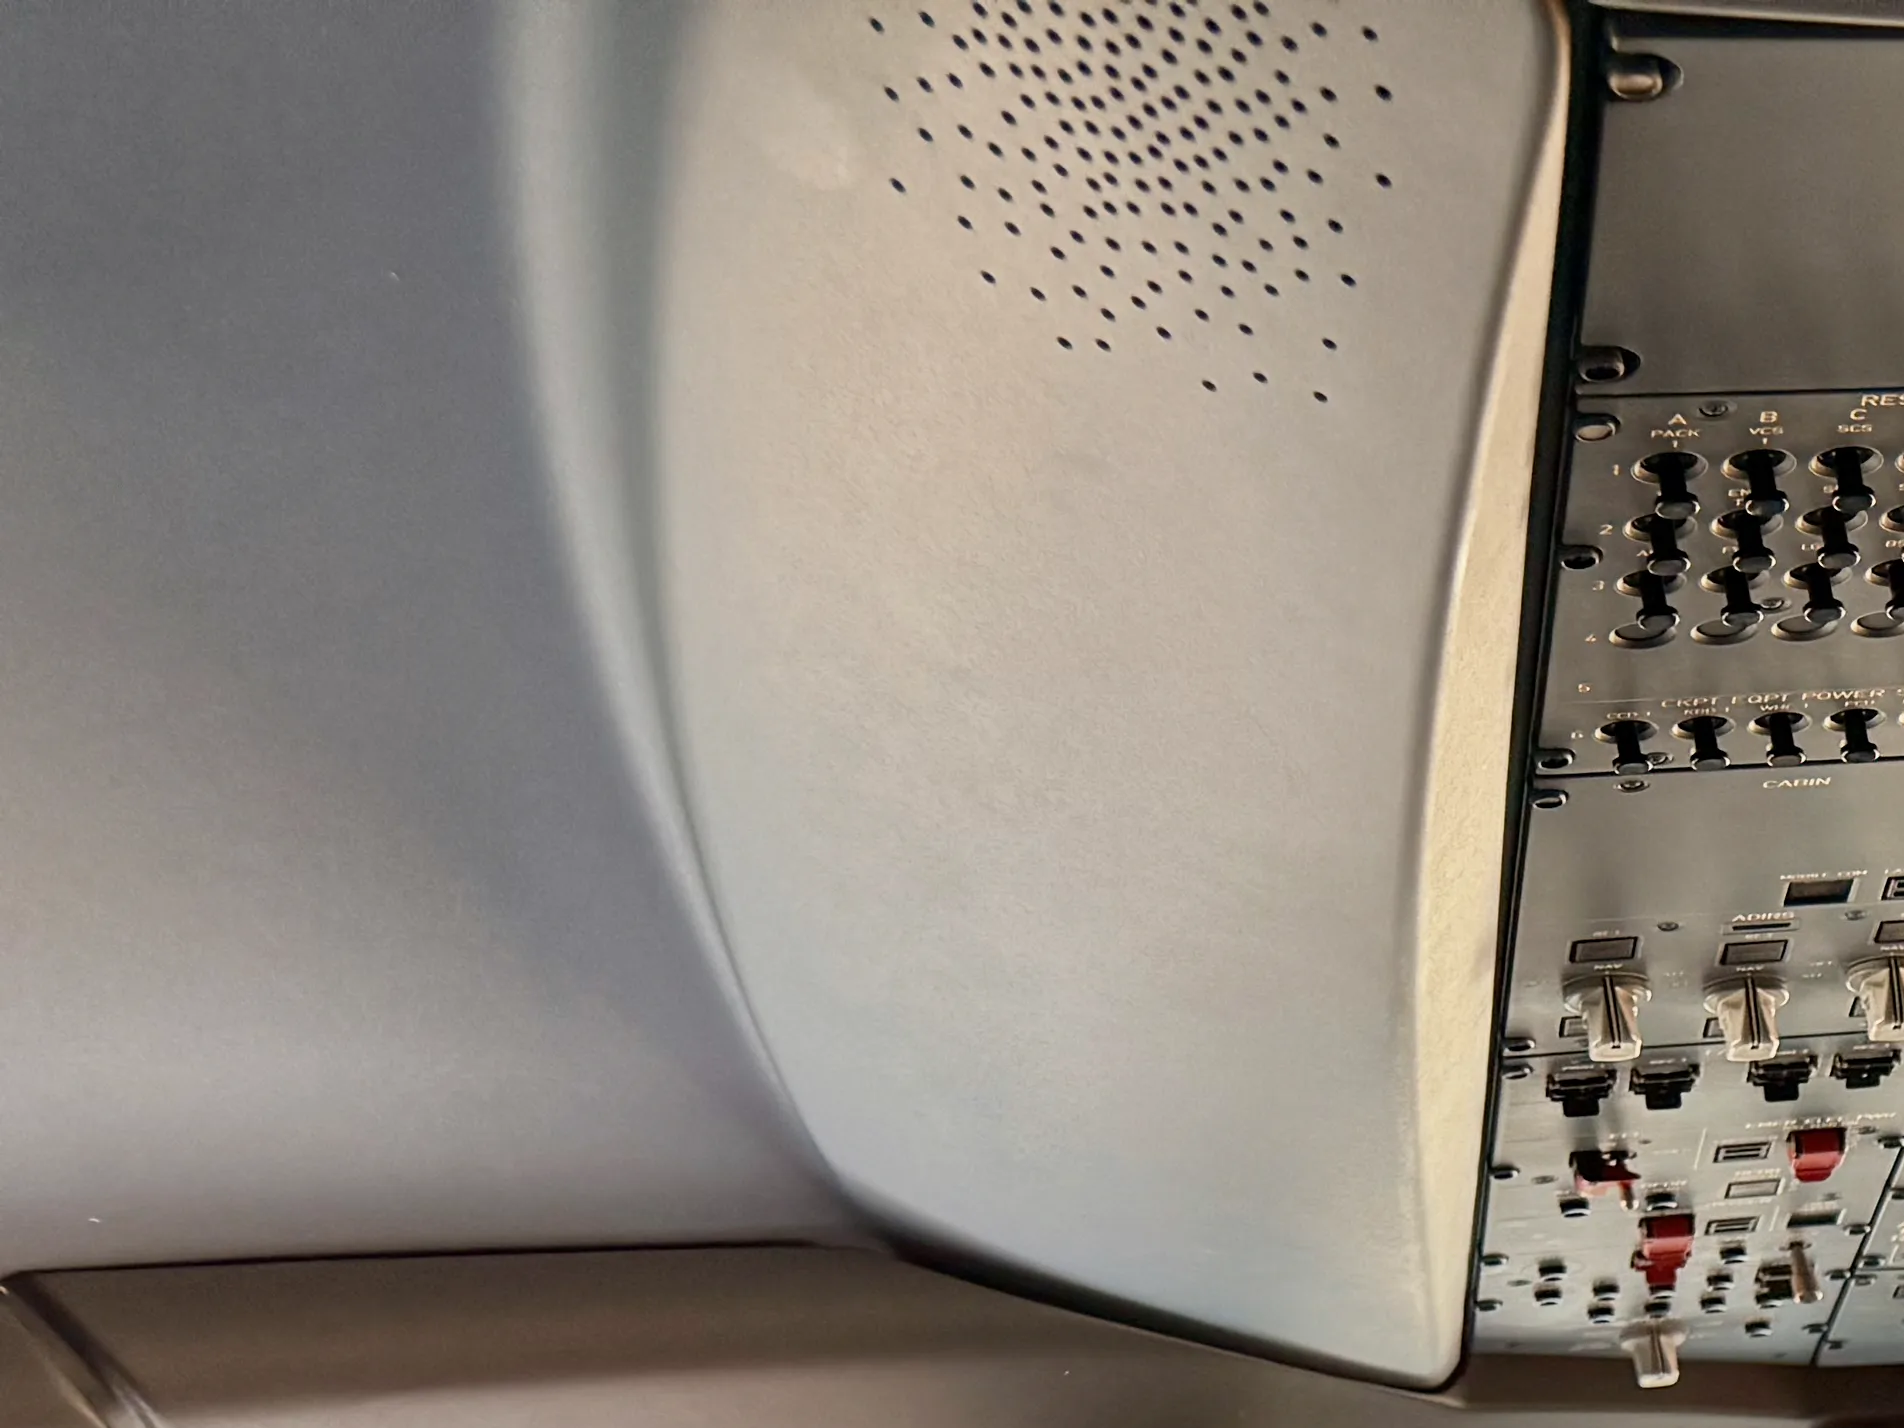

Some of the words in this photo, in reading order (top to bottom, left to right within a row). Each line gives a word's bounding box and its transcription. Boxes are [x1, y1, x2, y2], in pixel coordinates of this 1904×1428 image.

[1667, 412, 1688, 426] A
[1759, 410, 1779, 424] B
[1849, 408, 1868, 421] C
[1650, 427, 1701, 439] PACK
[1801, 688, 1886, 701] POWER
